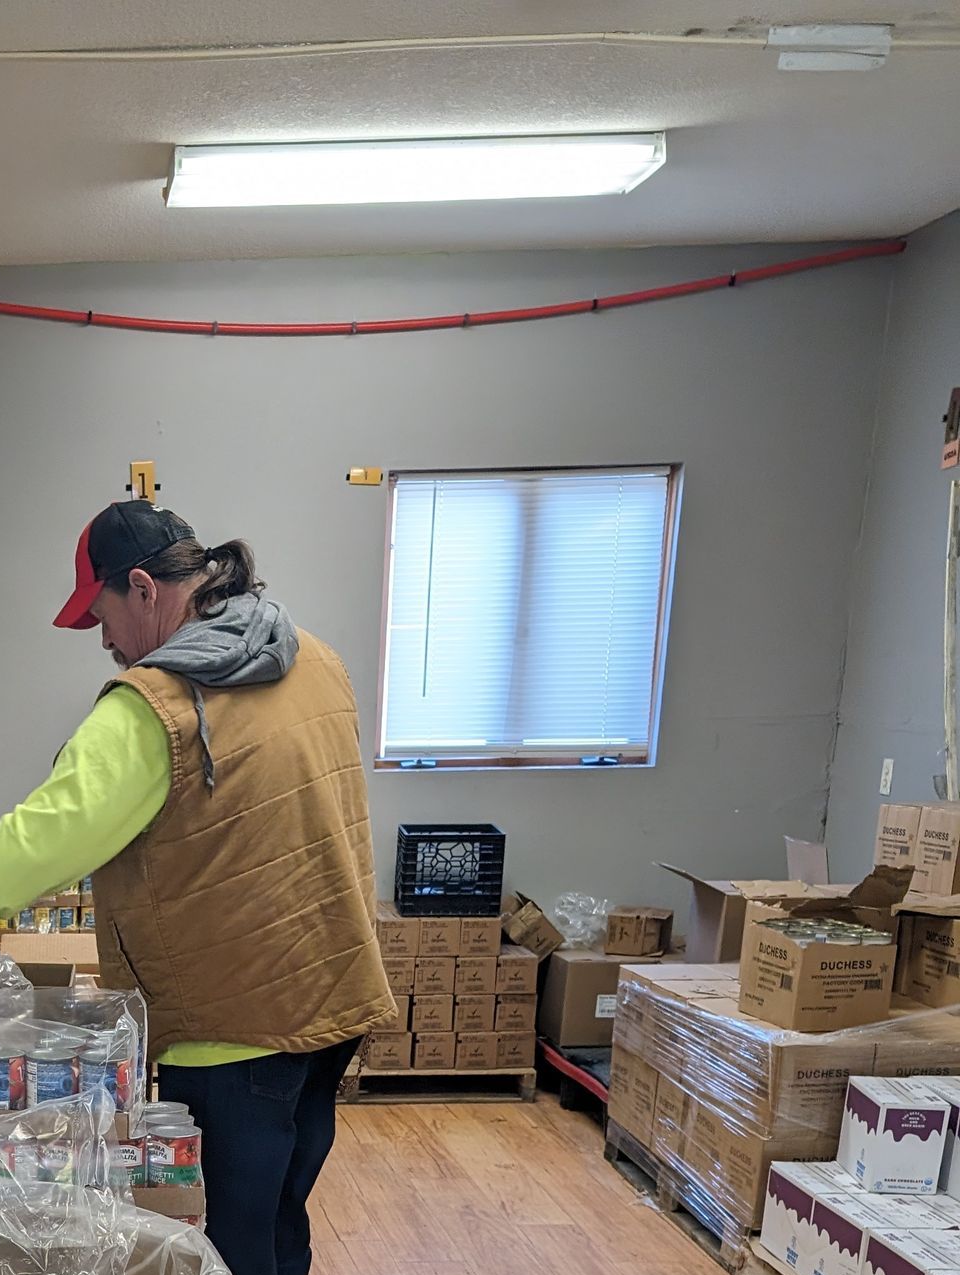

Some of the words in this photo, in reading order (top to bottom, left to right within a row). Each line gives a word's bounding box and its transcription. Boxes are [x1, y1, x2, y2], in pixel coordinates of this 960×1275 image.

[138, 472, 149, 499] 1
[883, 826, 906, 837] DUCHESS
[924, 829, 949, 841] DUCHESS
[926, 930, 955, 947] DUCHESS
[759, 942, 788, 961] DUCHESS
[820, 960, 872, 971] DUCHESS
[797, 1069, 850, 1080] DUCHESS
